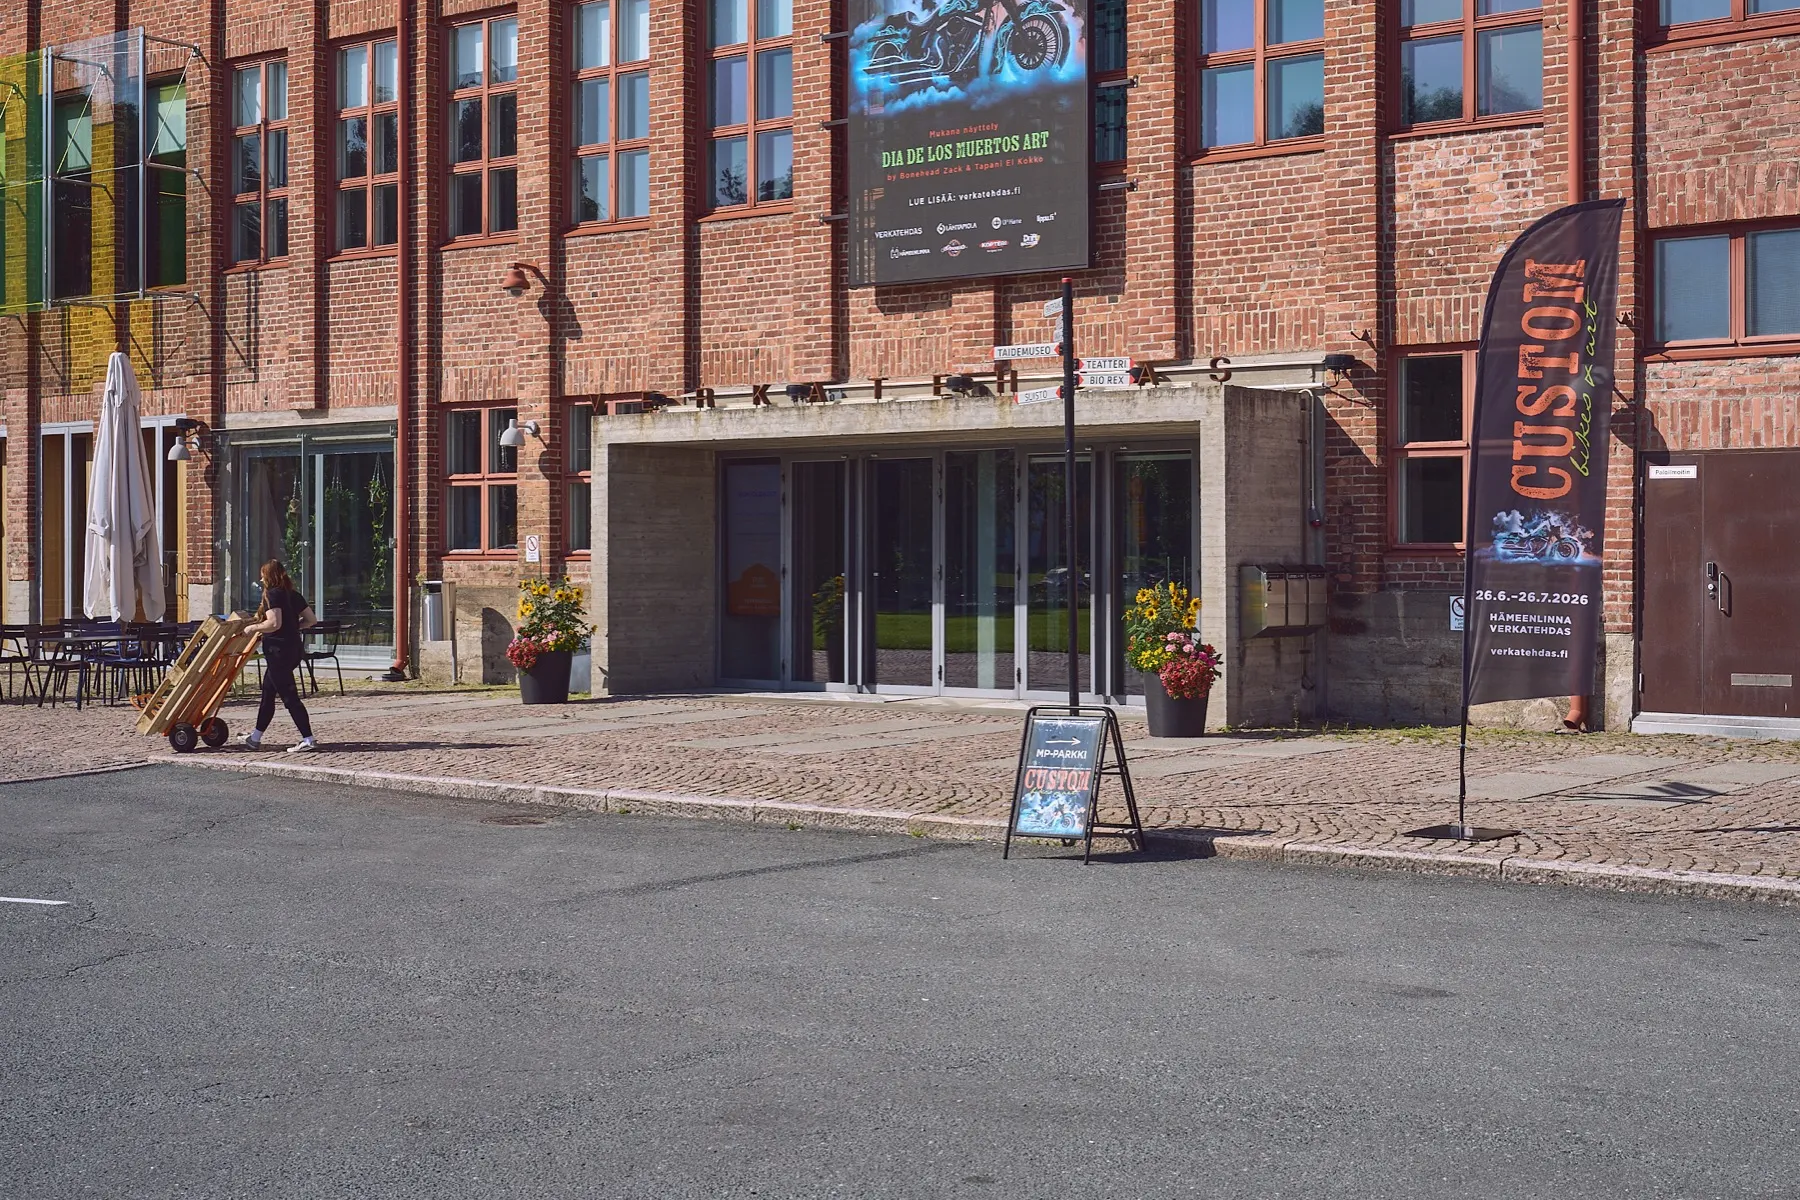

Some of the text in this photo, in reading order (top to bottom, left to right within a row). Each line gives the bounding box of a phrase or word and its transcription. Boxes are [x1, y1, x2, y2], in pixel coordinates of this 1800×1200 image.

[929, 122, 999, 138] Mukana näyttely
[882, 130, 1050, 168] DIA DE LOS MUERTOS ART
[887, 173, 897, 182] by
[899, 167, 940, 180] Bonehead
[943, 165, 963, 175] Zack
[974, 159, 1003, 171] Tapani
[1017, 155, 1044, 166] Kokko
[908, 186, 1022, 206] LUE LISÄÄ: verkatehdas.fi
[874, 227, 923, 239] VERKATEHDAS
[1581, 285, 1598, 357] art
[997, 346, 1051, 357] TAIDEMUSEO
[1086, 359, 1127, 369] TEATTERI
[589, 357, 1232, 412] VERKATEHAS
[1089, 375, 1124, 385] BIO REX
[1510, 258, 1586, 500] CUSTOM
[1570, 393, 1593, 477] bikes
[1267, 581, 1272, 591] 2
[1489, 611, 1572, 625] HÄMEENLINNA
[1489, 624, 1571, 636] VERKATEHDAS
[1490, 647, 1568, 659] verkatehdas.fi
[1036, 749, 1087, 760] MP-PARKKI
[1024, 769, 1090, 791] CUSTOM
